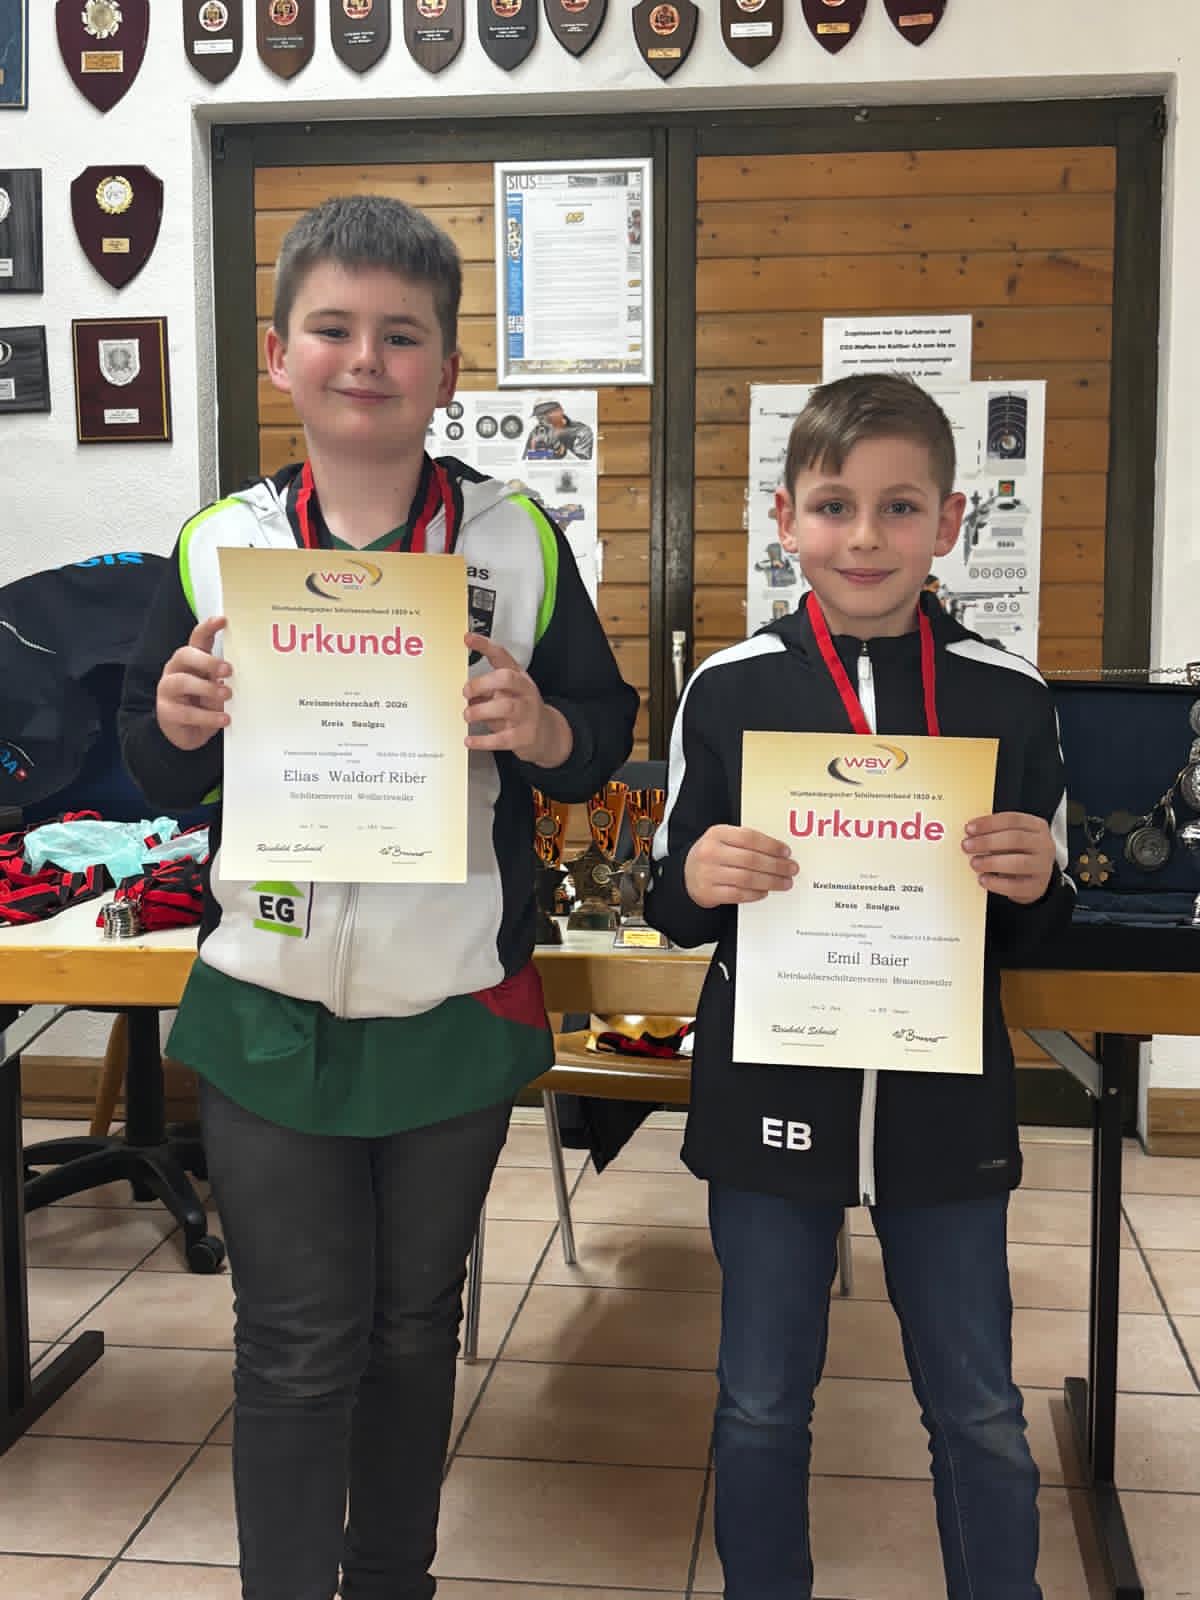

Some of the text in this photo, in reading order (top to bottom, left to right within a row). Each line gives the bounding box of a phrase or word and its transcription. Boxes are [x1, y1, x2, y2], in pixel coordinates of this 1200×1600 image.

[320, 571, 367, 585] WSV
[272, 624, 424, 656] Urkunde
[299, 698, 380, 709] Kreismeisterschaft
[321, 719, 344, 728] Kreis
[844, 757, 892, 769] WSV
[283, 769, 427, 784] Elias Waldorf Riber
[789, 809, 945, 841] Urkunde
[812, 881, 924, 893] Kreismeisterschaft 2026
[259, 894, 296, 924] EG
[834, 901, 858, 910] Kreis
[826, 951, 910, 967] Emil Baier
[761, 1115, 813, 1152] EB
